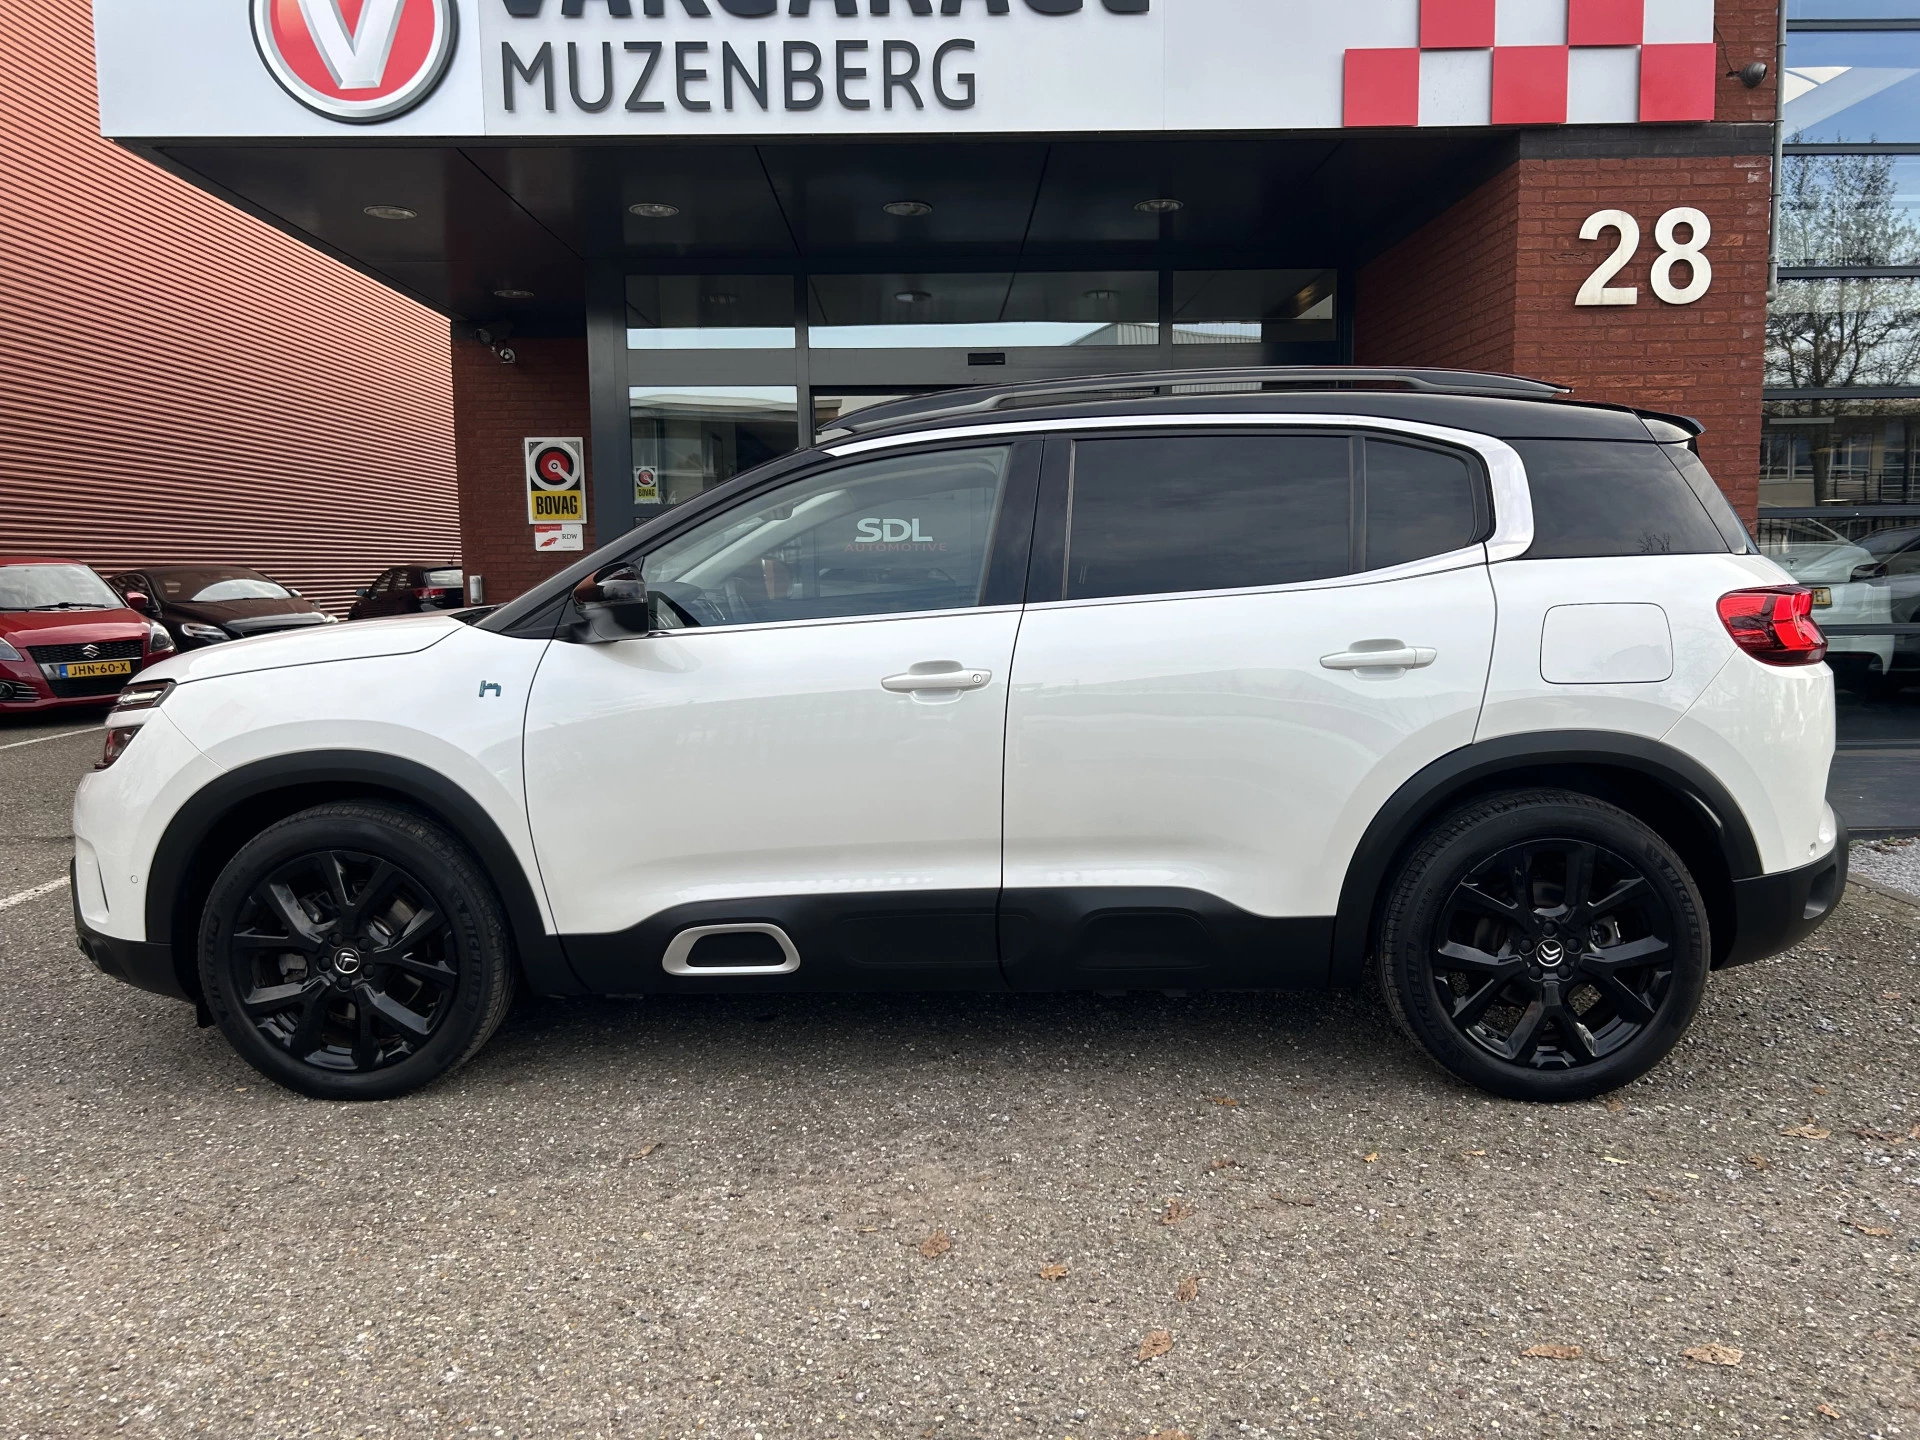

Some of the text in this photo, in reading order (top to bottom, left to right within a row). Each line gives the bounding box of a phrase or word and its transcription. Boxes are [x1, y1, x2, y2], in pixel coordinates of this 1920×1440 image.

[501, 38, 976, 112] MUZENBERG
[1574, 206, 1712, 306] 28
[638, 489, 656, 497] BOVAG
[535, 495, 578, 515] BOVAG
[854, 517, 934, 543] SDL
[844, 542, 948, 552] AUTOMOTIVE
[71, 662, 128, 676] JHN-60-X
